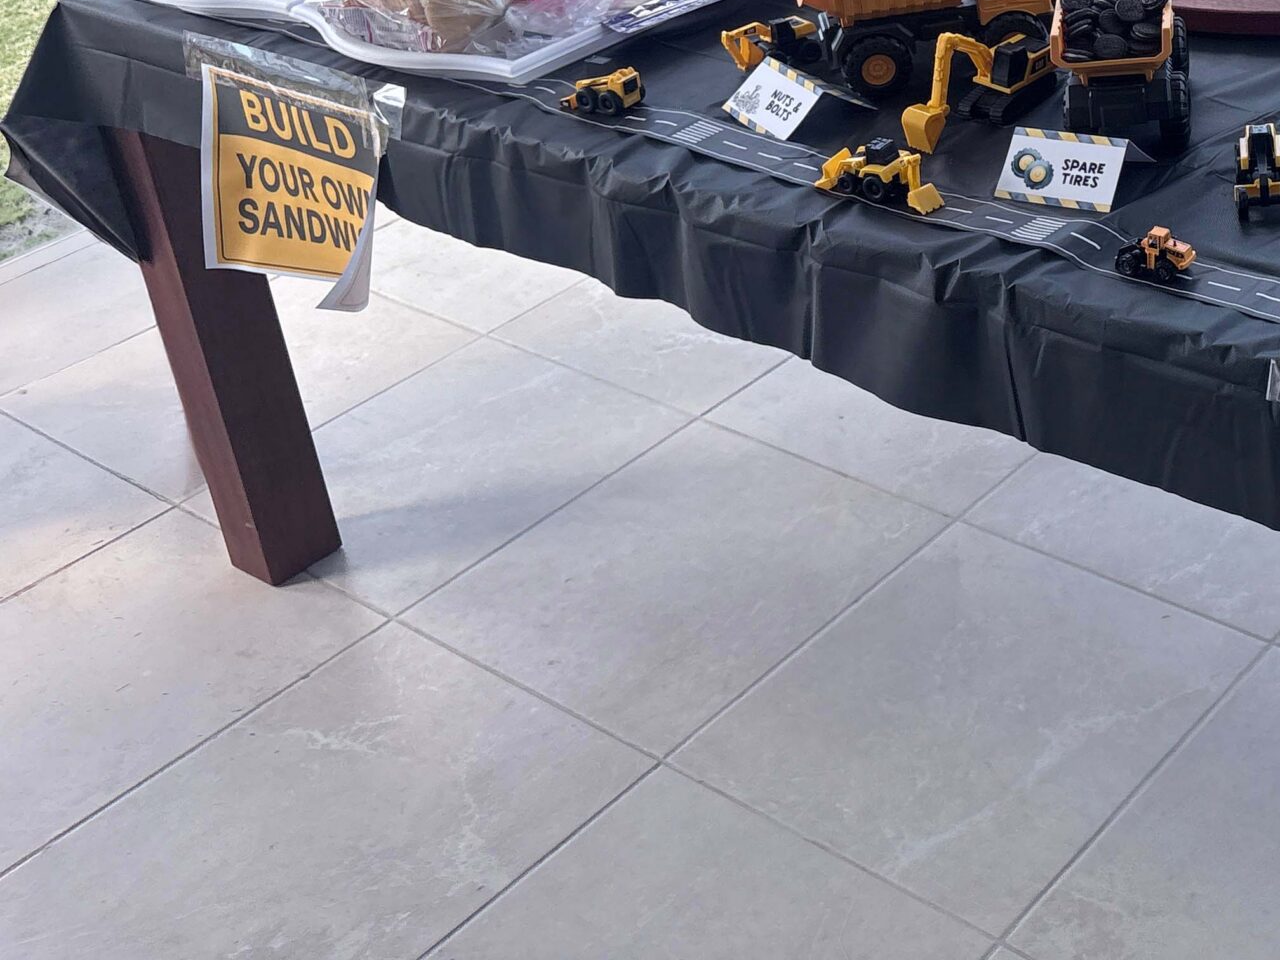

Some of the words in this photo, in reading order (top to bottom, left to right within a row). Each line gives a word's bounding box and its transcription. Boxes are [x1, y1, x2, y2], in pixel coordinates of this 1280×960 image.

[765, 100, 792, 121] BOLTS
[771, 89, 795, 107] NUTS
[792, 102, 802, 113] &
[240, 89, 357, 160] BUILD
[236, 153, 319, 204] YOUR
[1061, 159, 1106, 175] SPARE
[1062, 173, 1100, 188] TIRES
[238, 198, 363, 252] SANDWI
